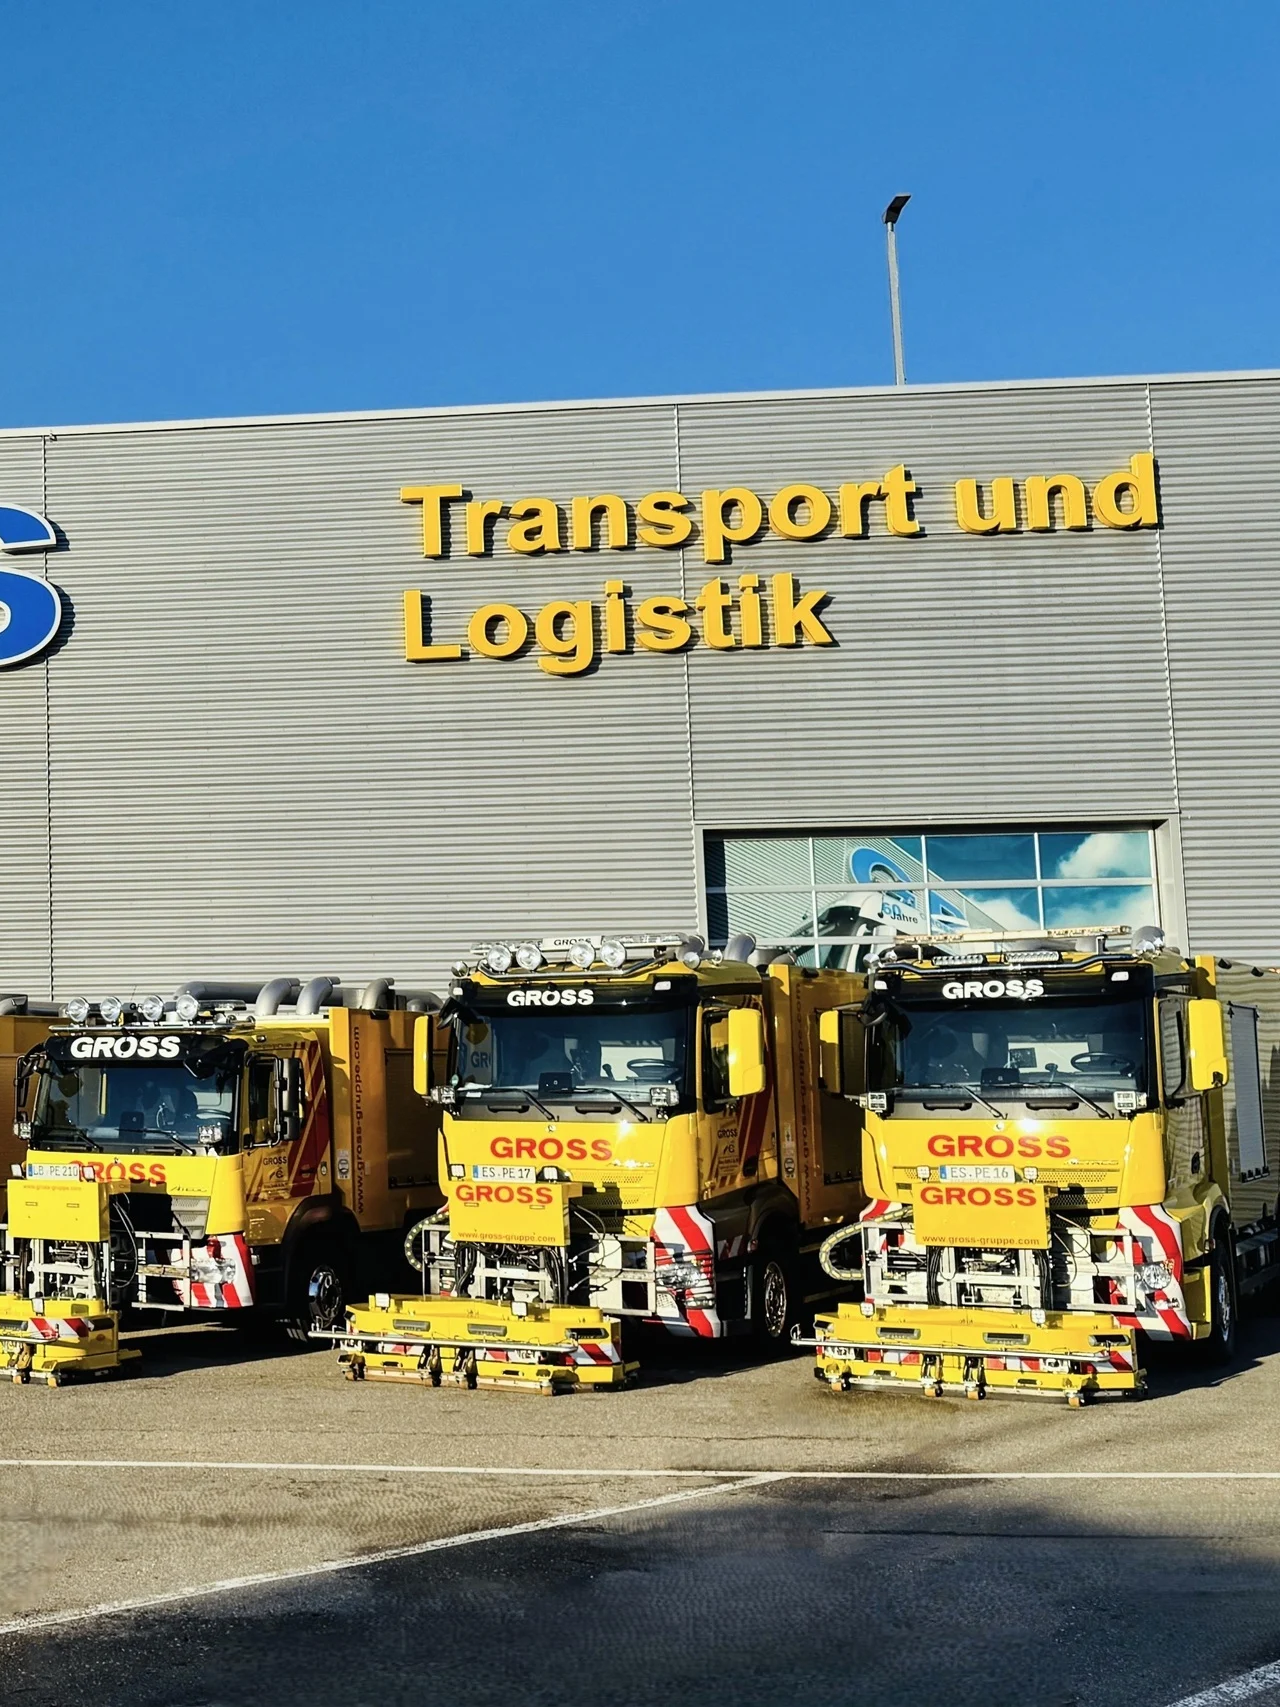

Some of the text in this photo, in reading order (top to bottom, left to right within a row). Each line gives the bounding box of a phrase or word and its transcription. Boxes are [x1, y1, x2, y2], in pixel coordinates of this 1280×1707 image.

[400, 452, 1159, 563] Transport und
[403, 572, 833, 676] Logistik
[890, 911, 918, 924] Jahre
[507, 988, 594, 1007] GROSS
[941, 978, 1045, 1000] GROSS
[70, 1035, 180, 1059] GROSS
[353, 1026, 364, 1214] www.gross-gruppe.com
[490, 1136, 612, 1161] GROSS
[927, 1134, 1071, 1159] GROSS
[50, 1166, 60, 1176] PE
[263, 1156, 287, 1166] GROSS
[518, 1168, 531, 1179] 17
[993, 1167, 1009, 1179] 16
[455, 1184, 553, 1204] GROSS
[920, 1186, 1037, 1206] GROSS
[458, 1230, 556, 1243] www.gross-gruppe.com
[922, 1235, 1040, 1246] www.gross-gruppe.com
